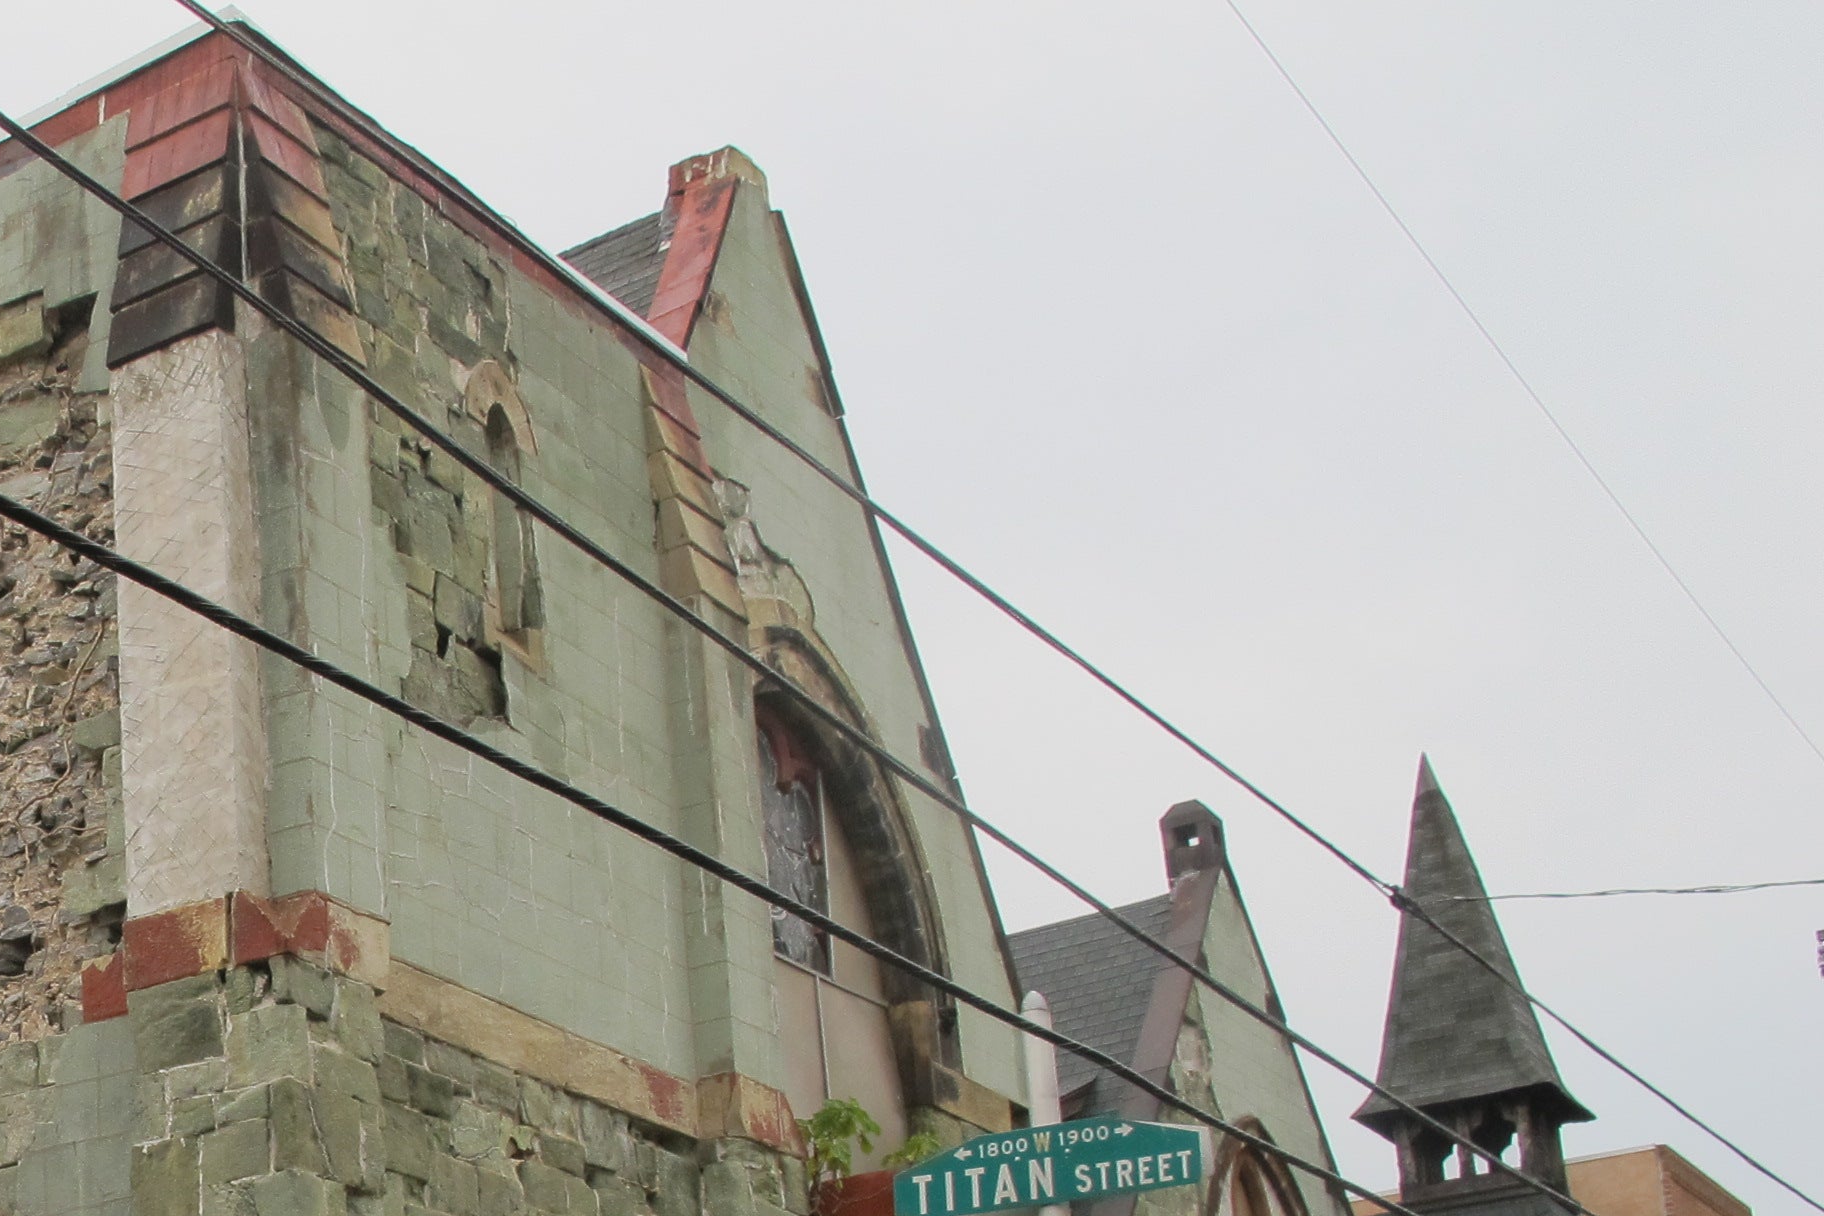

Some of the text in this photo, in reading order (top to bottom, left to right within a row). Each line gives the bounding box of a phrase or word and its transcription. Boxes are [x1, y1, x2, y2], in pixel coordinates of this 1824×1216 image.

[979, 1125, 1109, 1159] 1800 W 1900
[912, 1150, 1193, 1215] TITAN STREET
